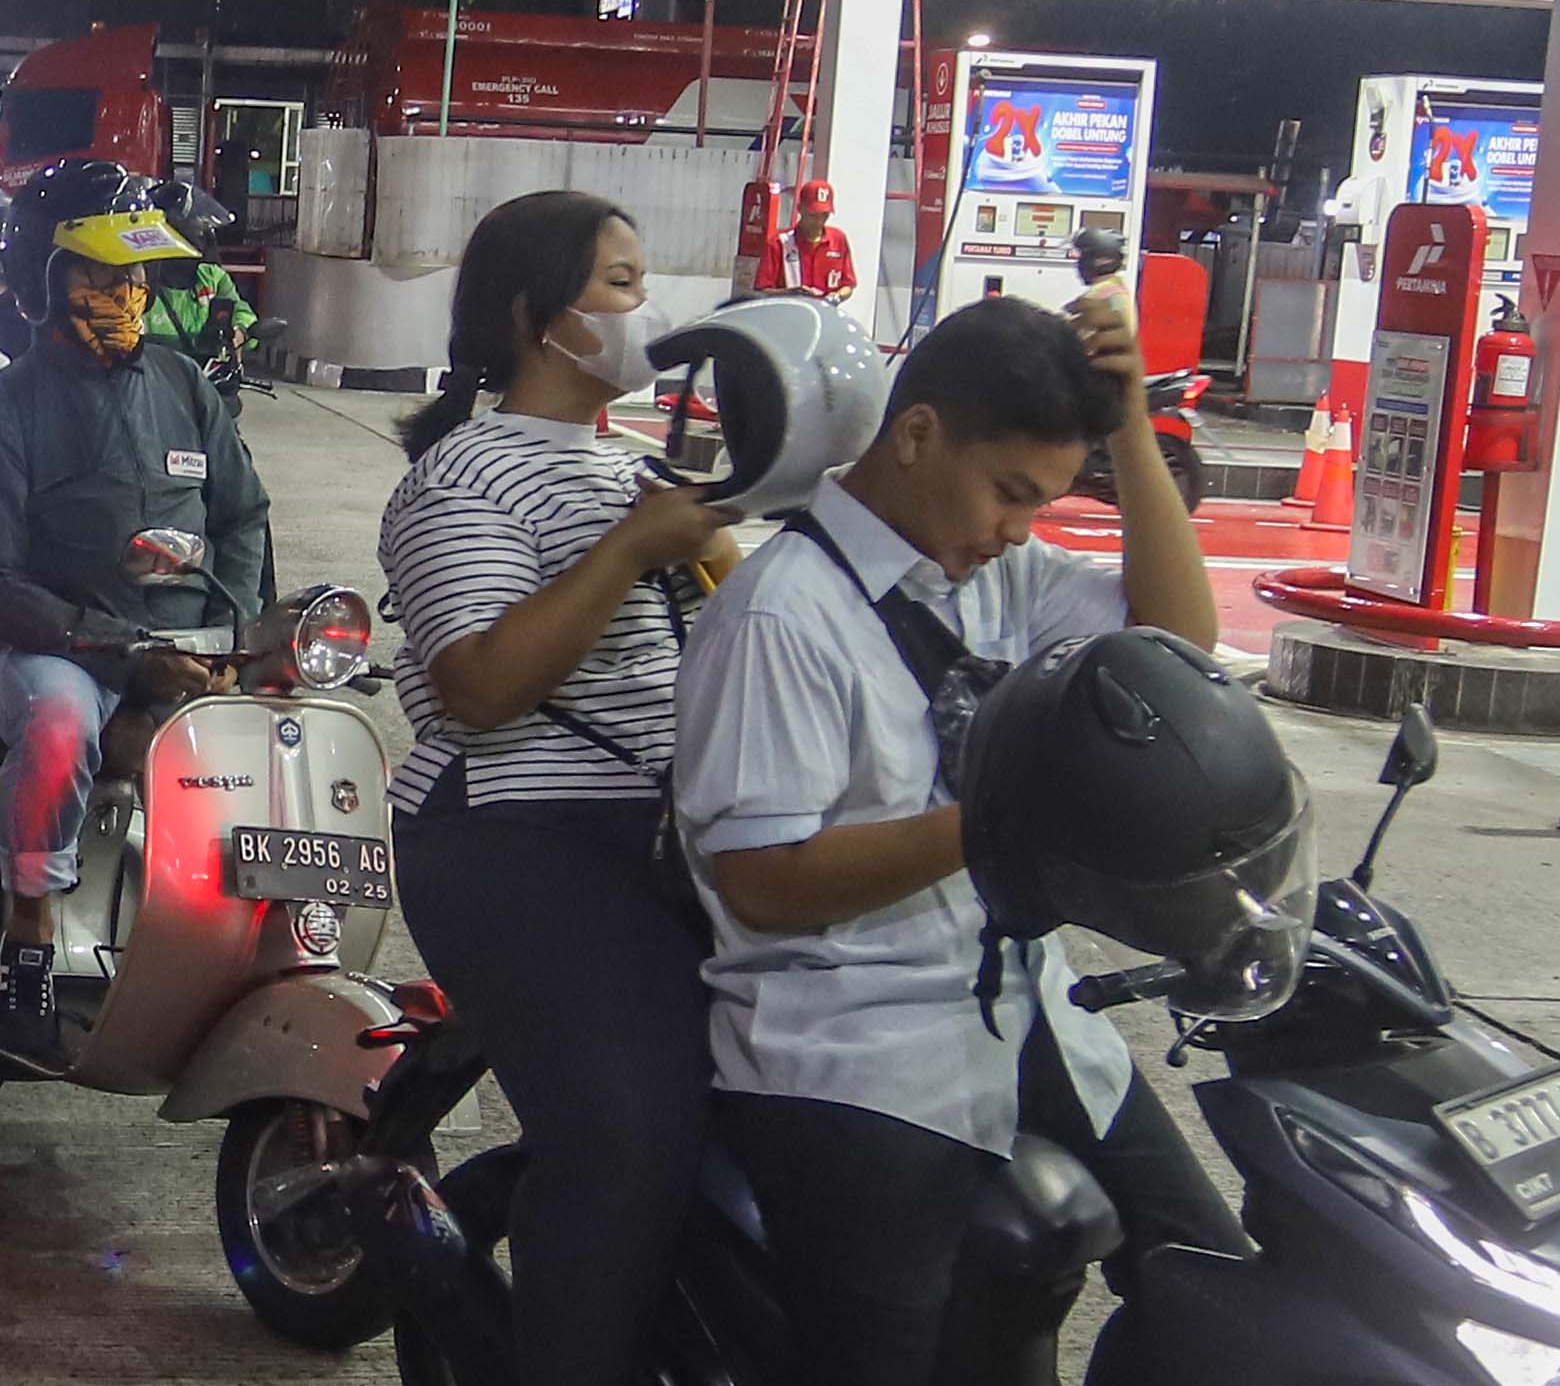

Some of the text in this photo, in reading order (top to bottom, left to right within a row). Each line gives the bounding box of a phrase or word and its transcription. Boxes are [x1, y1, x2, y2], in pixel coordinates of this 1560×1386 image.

[472, 81, 559, 95] EMERGENCY CALL
[1052, 111, 1128, 129] AKHIR PEKAN
[984, 101, 1042, 159] 2X
[1085, 127, 1127, 143] UNTUNG
[1489, 136, 1521, 151] AKHIR
[240, 832, 387, 874] BK 2956 AG
[1455, 1119, 1499, 1160] B
